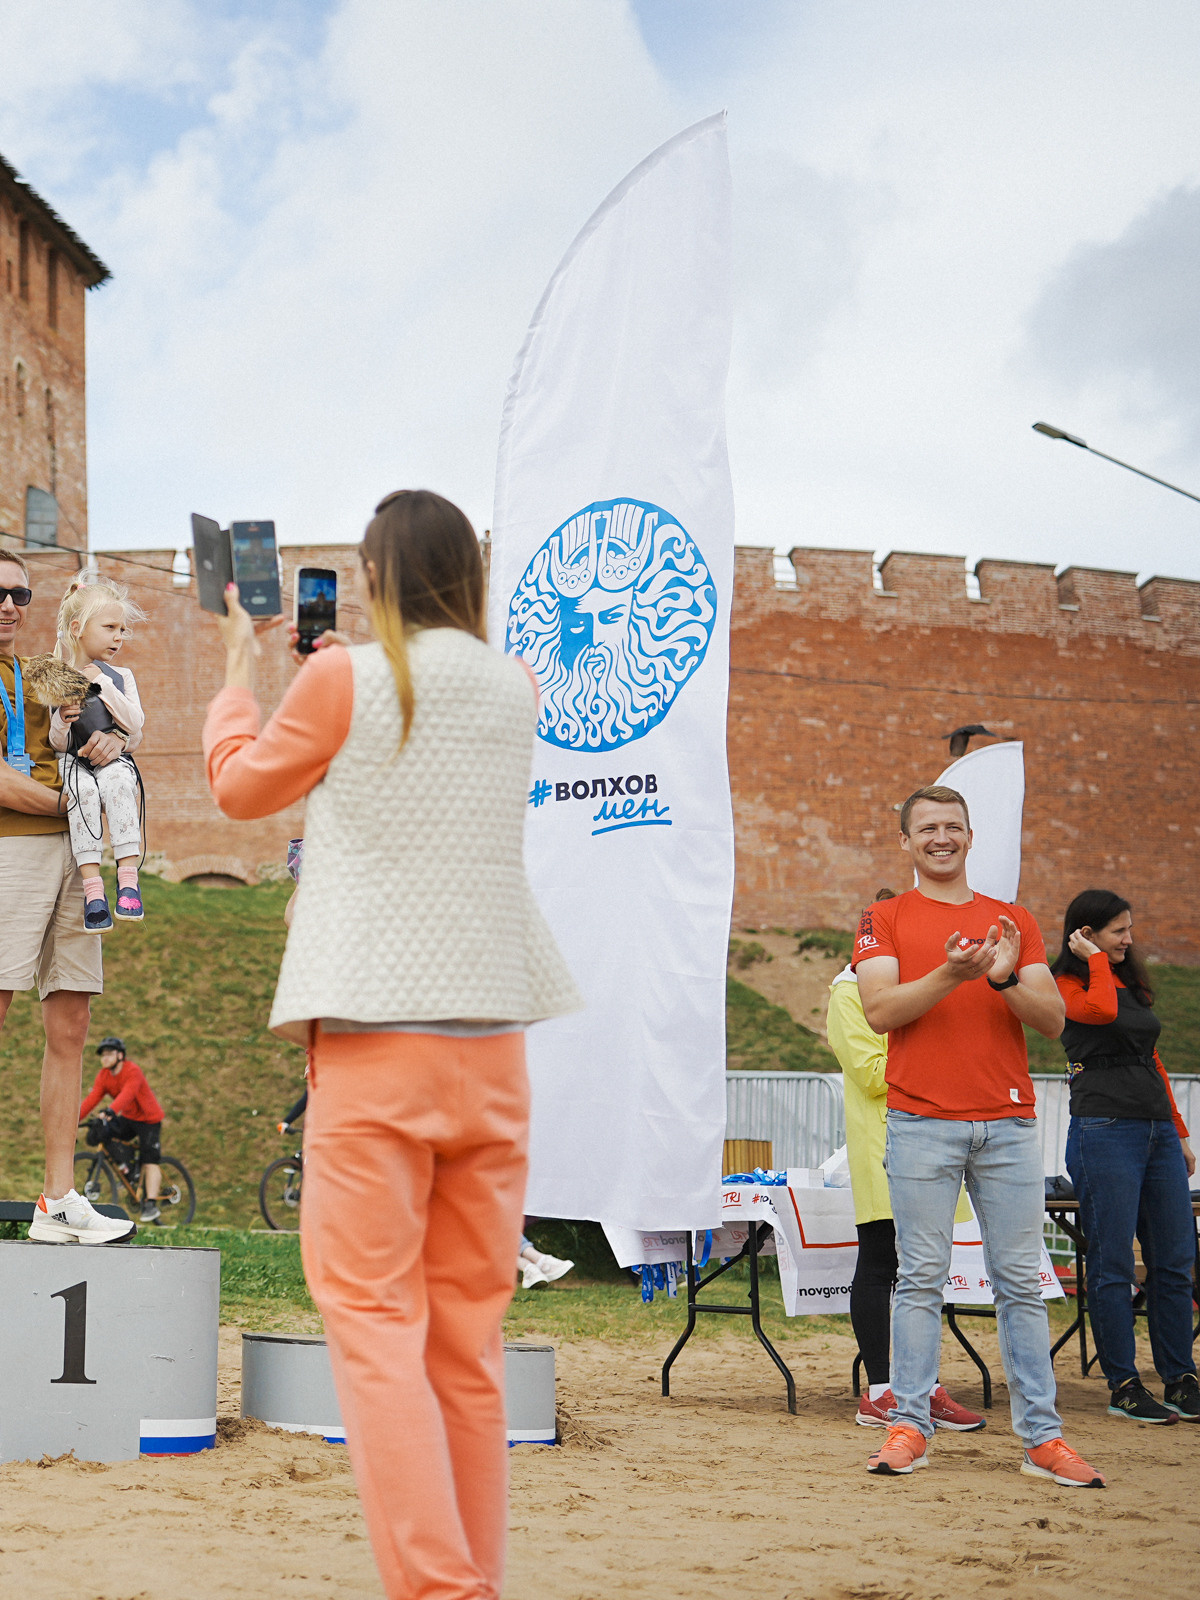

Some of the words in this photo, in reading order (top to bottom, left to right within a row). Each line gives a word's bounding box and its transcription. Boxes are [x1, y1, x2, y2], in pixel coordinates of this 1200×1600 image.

[528, 774, 658, 807] #ВОЛХОВ
[593, 797, 670, 822] мен
[50, 1280, 97, 1384] 1
